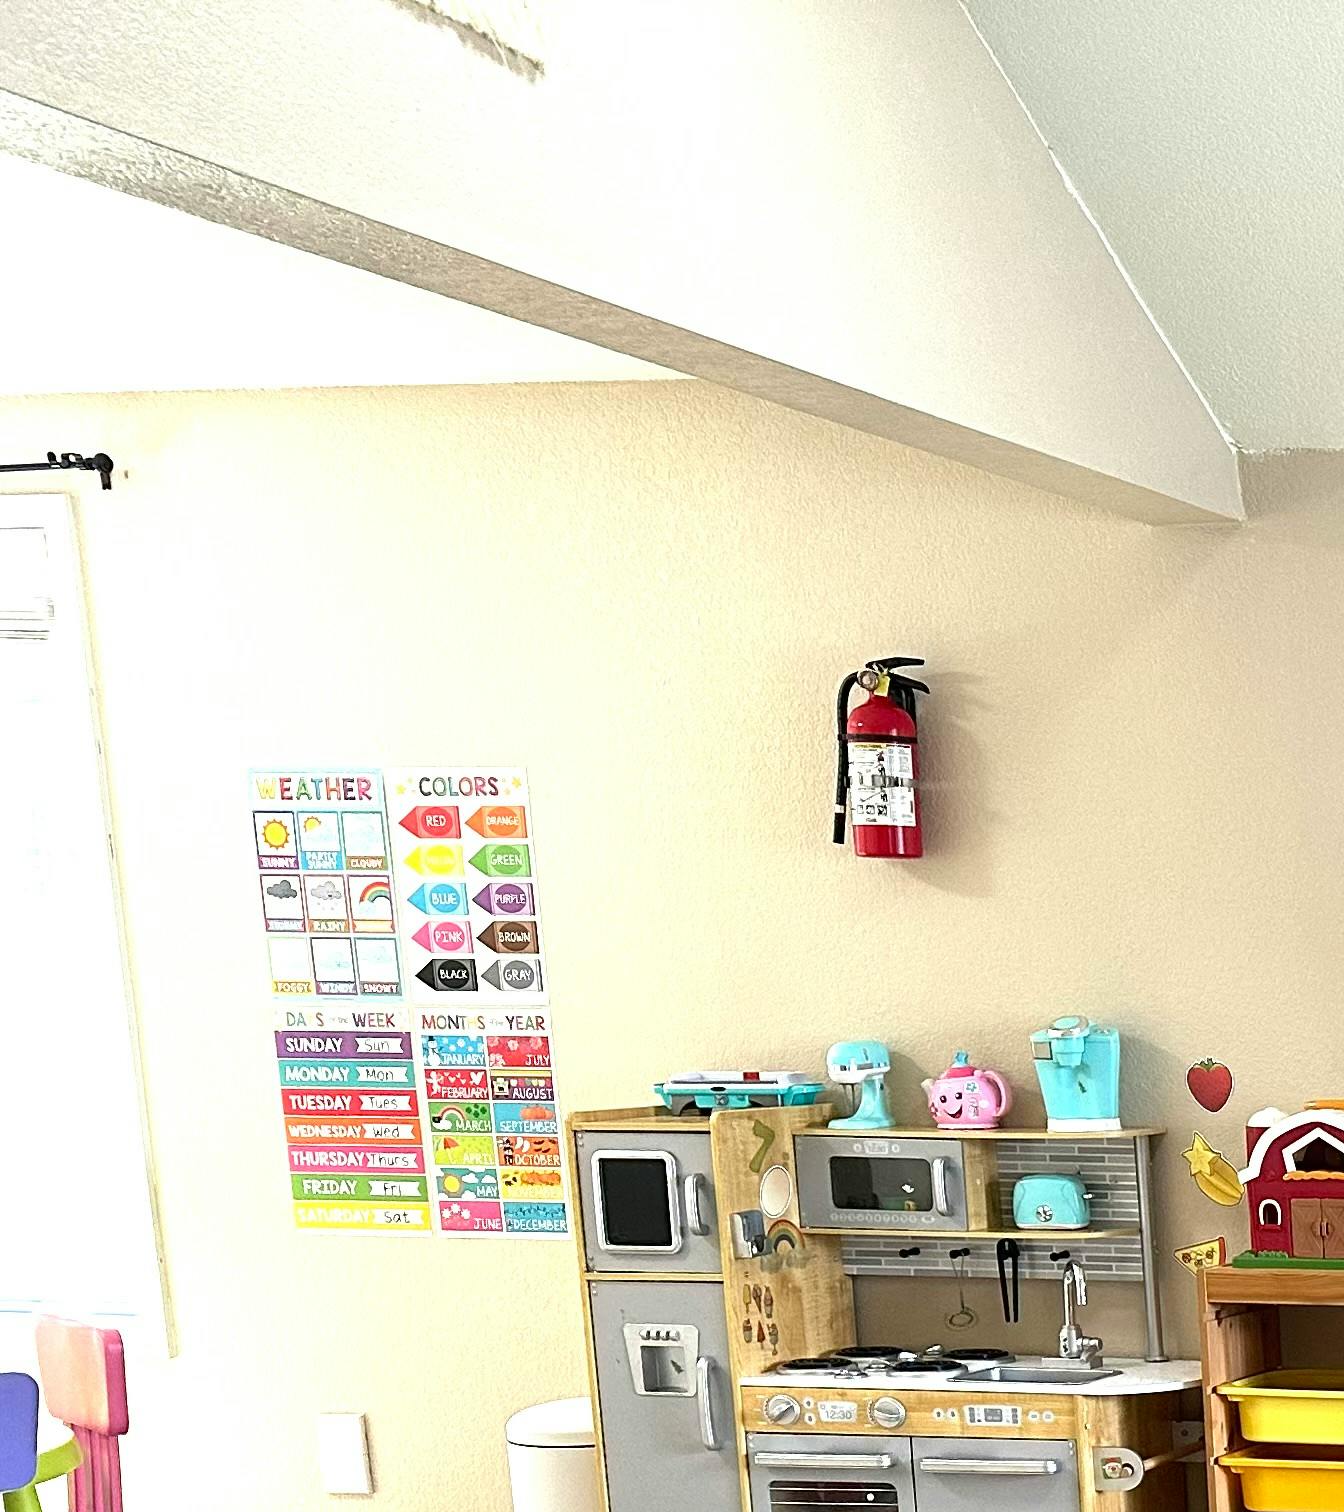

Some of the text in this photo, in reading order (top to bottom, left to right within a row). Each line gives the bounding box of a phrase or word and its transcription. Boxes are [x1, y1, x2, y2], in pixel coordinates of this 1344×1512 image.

[256, 777, 372, 800] WEATHER
[419, 776, 499, 797] COLORS
[425, 815, 446, 827] RED
[486, 816, 520, 826] ORANGE
[490, 854, 523, 866] GREEN
[432, 893, 458, 905] BLUE
[494, 893, 526, 904] PURPLE
[435, 931, 463, 944] PINK
[498, 931, 531, 943] BROWN
[439, 969, 468, 980] BLACK
[505, 968, 532, 981] GRAY
[352, 1012, 395, 1027] WEEK
[505, 1015, 546, 1031] YEAR
[285, 1037, 390, 1053] SUNDAY Sun
[440, 1053, 485, 1066] JANUARY
[525, 1054, 551, 1066] JULY
[285, 1066, 394, 1082] MONDAY Mon
[512, 1087, 553, 1099] AUGUST
[289, 1095, 398, 1111] TUESDAY Tues
[288, 1124, 400, 1138] WEDNESDAY Wed
[455, 1120, 491, 1132] MARCH
[500, 1120, 558, 1133] SEPTEMBER
[290, 1151, 410, 1167] THURSDAY Thurs
[514, 1153, 561, 1166] OCTOBER
[302, 1179, 358, 1195] FRIDAY
[476, 1186, 498, 1197] MAY
[384, 1211, 411, 1224] Sat
[473, 1217, 503, 1230] JUNE
[513, 1219, 568, 1232] DECEMBER
[824, 1410, 852, 1420] 12:30
